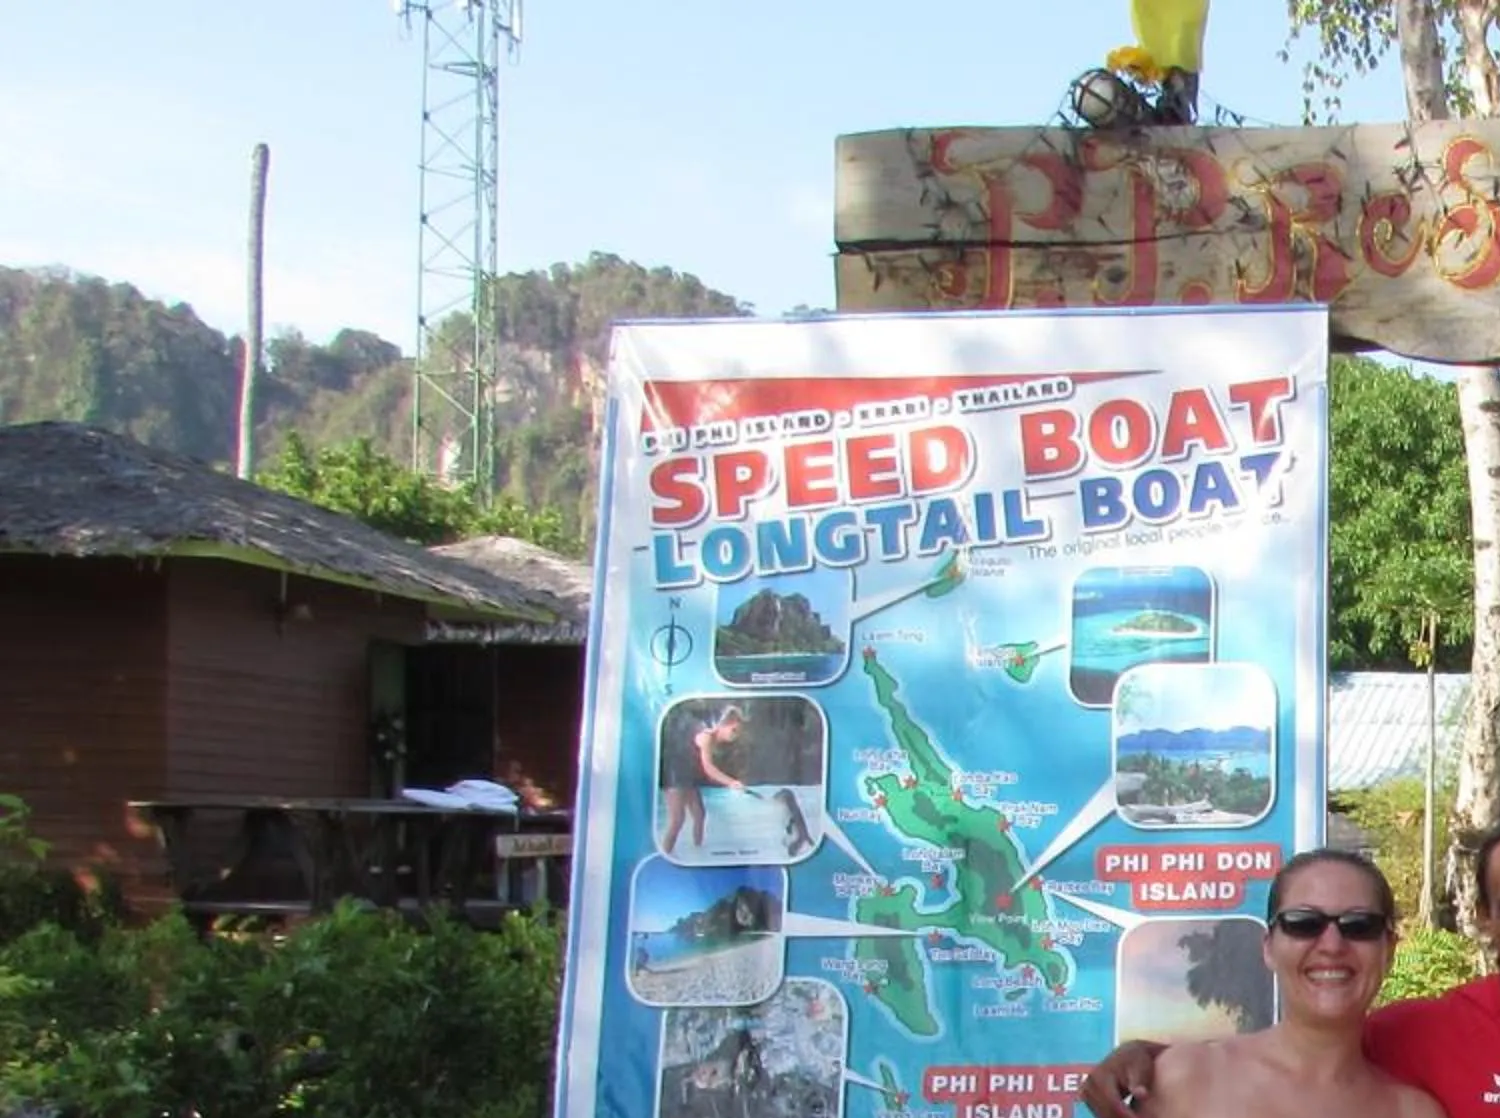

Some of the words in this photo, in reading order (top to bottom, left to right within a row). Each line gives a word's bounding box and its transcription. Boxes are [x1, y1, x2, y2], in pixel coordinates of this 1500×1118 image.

[958, 380, 1069, 407] THAILAND
[648, 425, 970, 524] SPEED
[1019, 376, 1290, 477] BOAT
[654, 488, 1046, 585] LONGTAIL
[1028, 543, 1058, 560] The
[1063, 532, 1121, 557] original
[1105, 853, 1149, 873] PHI
[1161, 852, 1205, 872] PHI
[1216, 851, 1273, 871] DON
[1139, 881, 1237, 902] ISLAND
[931, 1074, 977, 1093] PHI
[989, 1073, 1033, 1092] PHI
